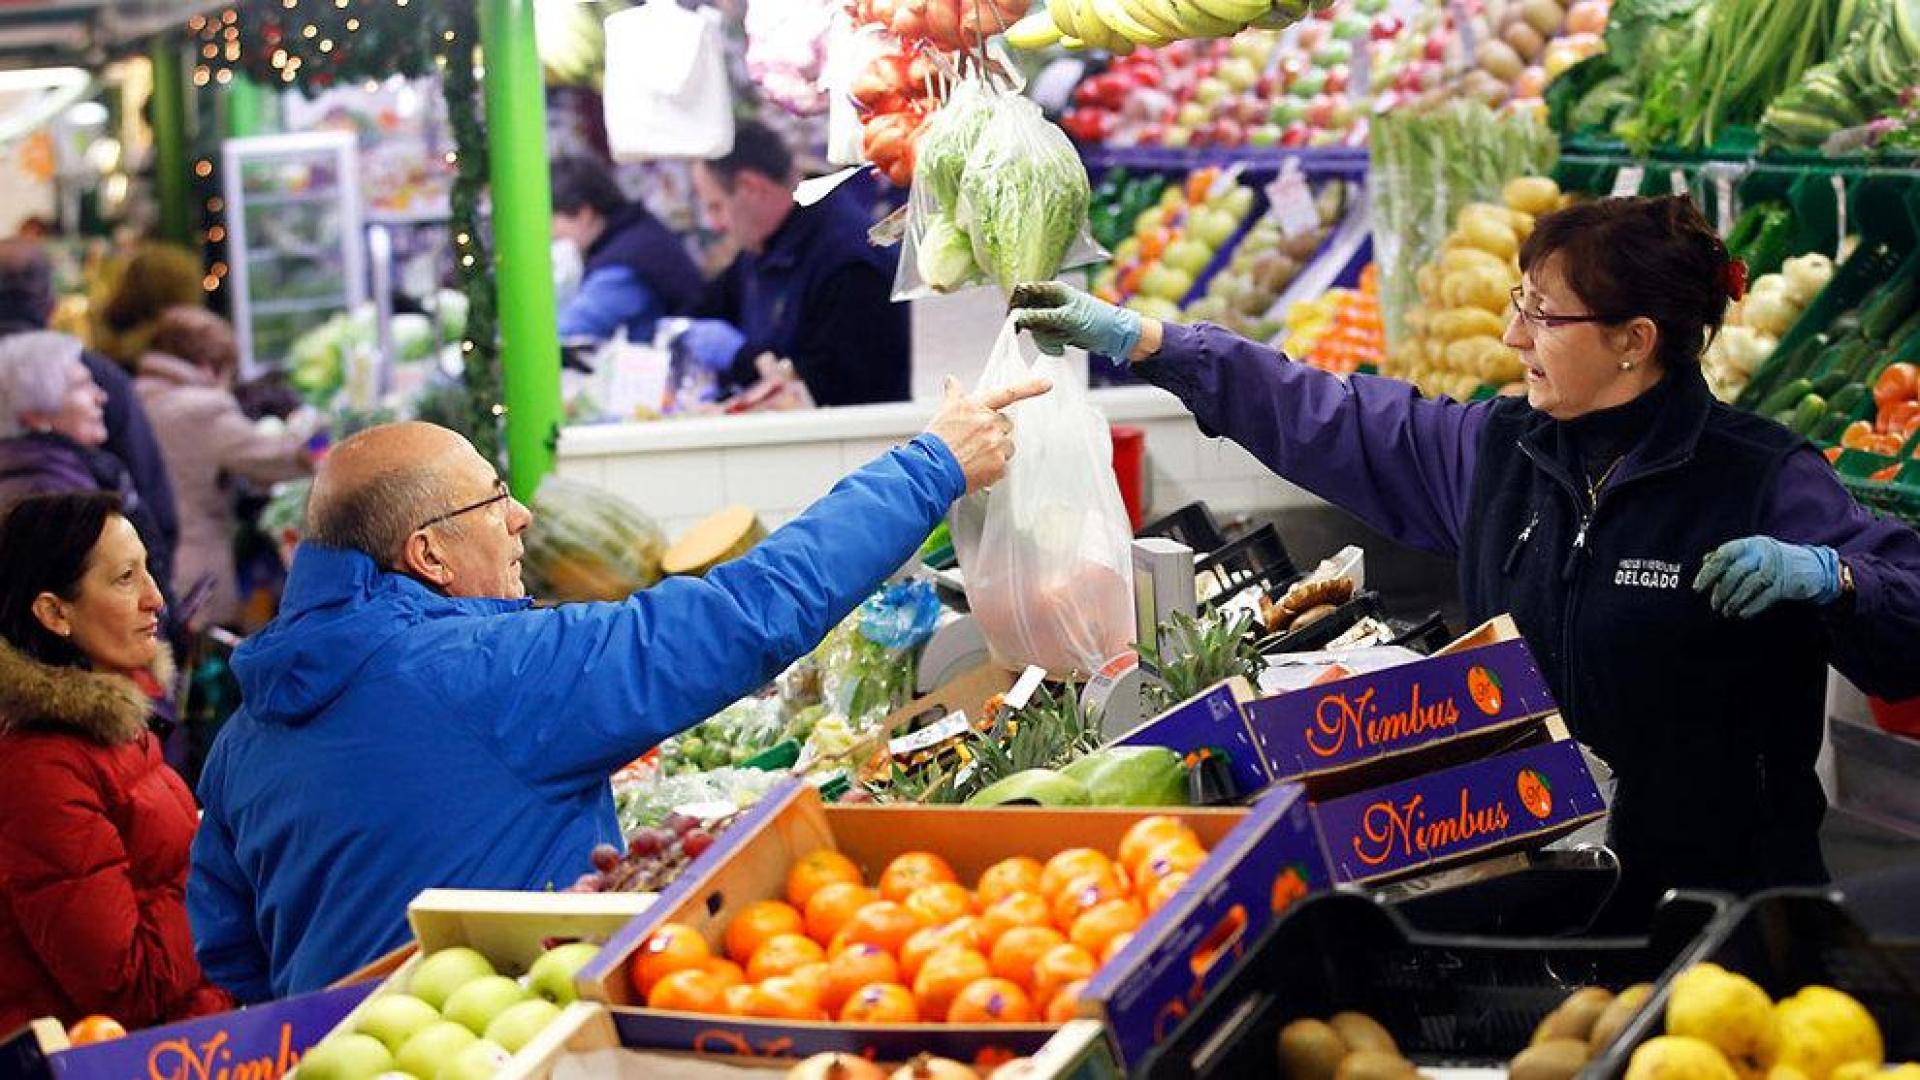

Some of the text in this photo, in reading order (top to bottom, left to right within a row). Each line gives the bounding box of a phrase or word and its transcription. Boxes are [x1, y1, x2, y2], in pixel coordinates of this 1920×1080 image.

[1614, 569, 1679, 589] DELGADO
[1305, 682, 1461, 757] Nimbus
[1353, 788, 1510, 865] Nimbus
[136, 1022, 300, 1080] Nimb
